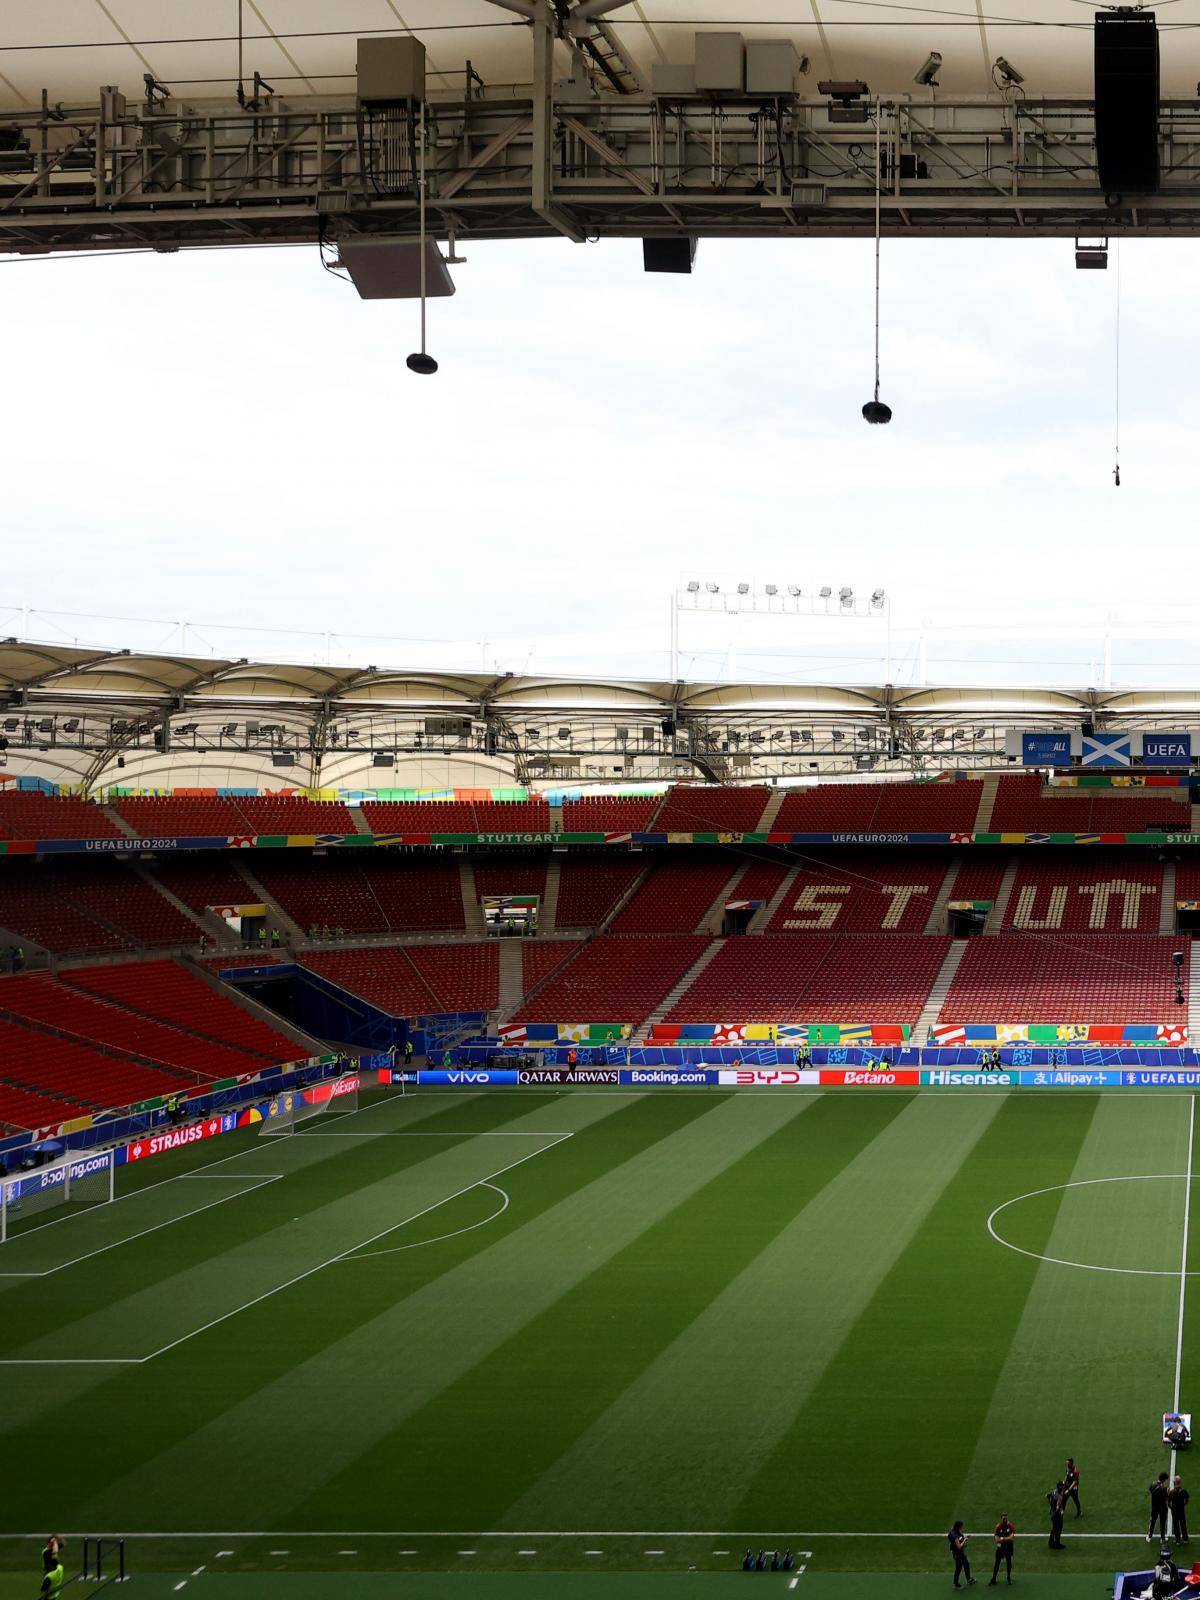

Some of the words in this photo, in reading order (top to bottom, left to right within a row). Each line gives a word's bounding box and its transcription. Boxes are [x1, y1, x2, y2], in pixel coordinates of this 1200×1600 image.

[1147, 744, 1186, 756] UEFA
[477, 833, 561, 843] STUTTGART
[447, 1071, 489, 1083] vivo
[519, 1071, 560, 1084] QATAR
[565, 1071, 618, 1082] AIRWAYS
[631, 1071, 706, 1084] Booking.com
[736, 1071, 800, 1084] BYD
[844, 1071, 896, 1085] Betano
[929, 1071, 1011, 1085] Hisense
[150, 1125, 203, 1154] STRAUSS
